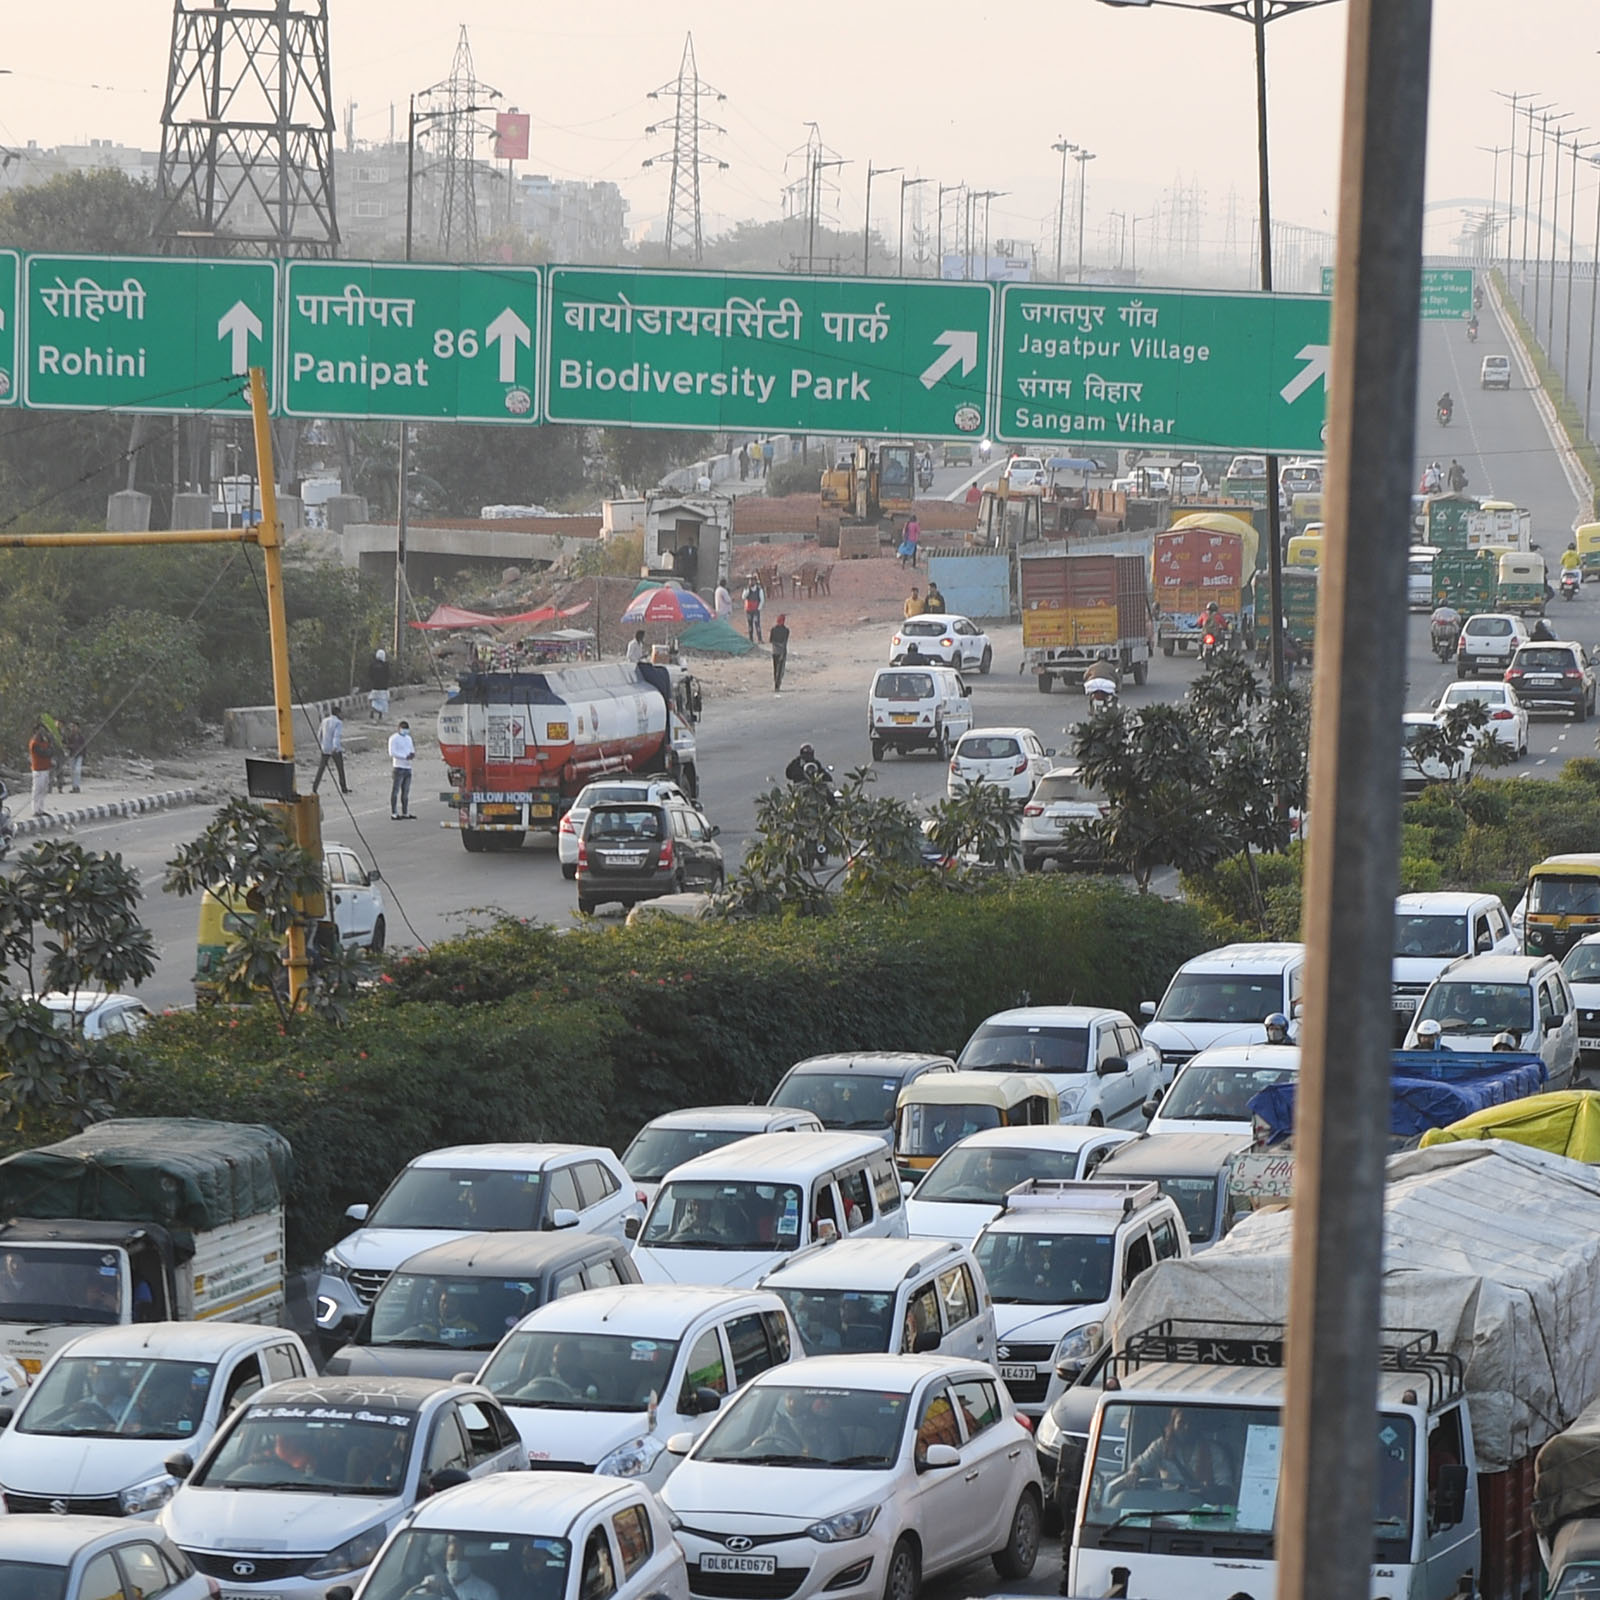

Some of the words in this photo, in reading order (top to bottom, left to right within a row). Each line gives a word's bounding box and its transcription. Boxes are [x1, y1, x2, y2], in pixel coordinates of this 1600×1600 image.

[40, 277, 146, 321] रोहिणी
[296, 284, 416, 328] पानीपत
[1020, 302, 1105, 332] जगतपुर
[1118, 296, 1158, 330] गाँव
[562, 292, 802, 342] बायोडायवर्सिटी
[823, 301, 890, 344] पार्क
[433, 329, 479, 359] 86
[1018, 335, 1120, 363] Jagatpur
[1130, 338, 1211, 364] Village
[37, 344, 146, 378] Rohini
[293, 352, 429, 390] Panipat
[558, 357, 776, 405] Biodiversity
[790, 368, 871, 402] Park
[1017, 375, 1073, 403] संगम
[1084, 374, 1142, 405] विहार
[1015, 409, 1105, 437] Sangam
[1115, 411, 1175, 435] Vihar
[473, 792, 503, 802] BLOW
[506, 793, 533, 803] HORN
[1001, 1368, 1035, 1379] AE4337
[354, 1411, 388, 1423] Ram
[708, 1557, 774, 1572] DL8CAE0676
